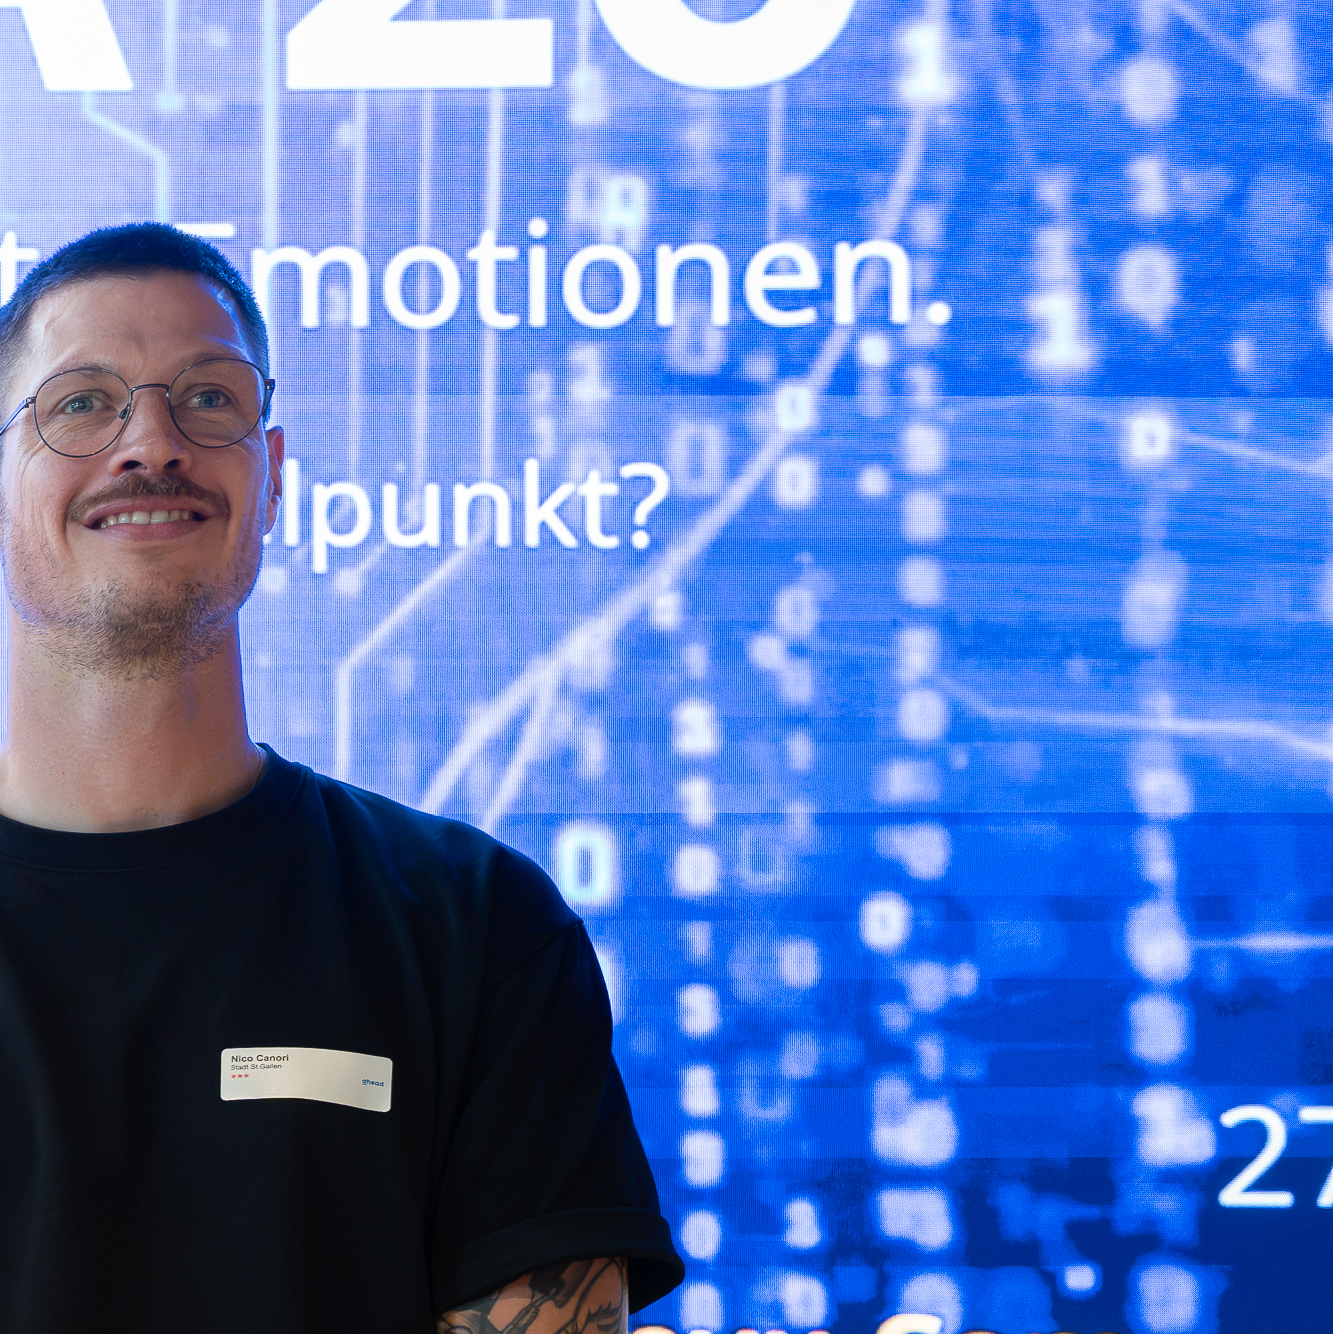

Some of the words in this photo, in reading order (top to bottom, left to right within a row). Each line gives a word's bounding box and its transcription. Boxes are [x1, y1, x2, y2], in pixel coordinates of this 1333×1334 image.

[174, 218, 952, 331] motionen.
[263, 458, 671, 575] lpunkt?
[231, 1055, 253, 1063] Nico
[256, 1053, 290, 1062] Canori
